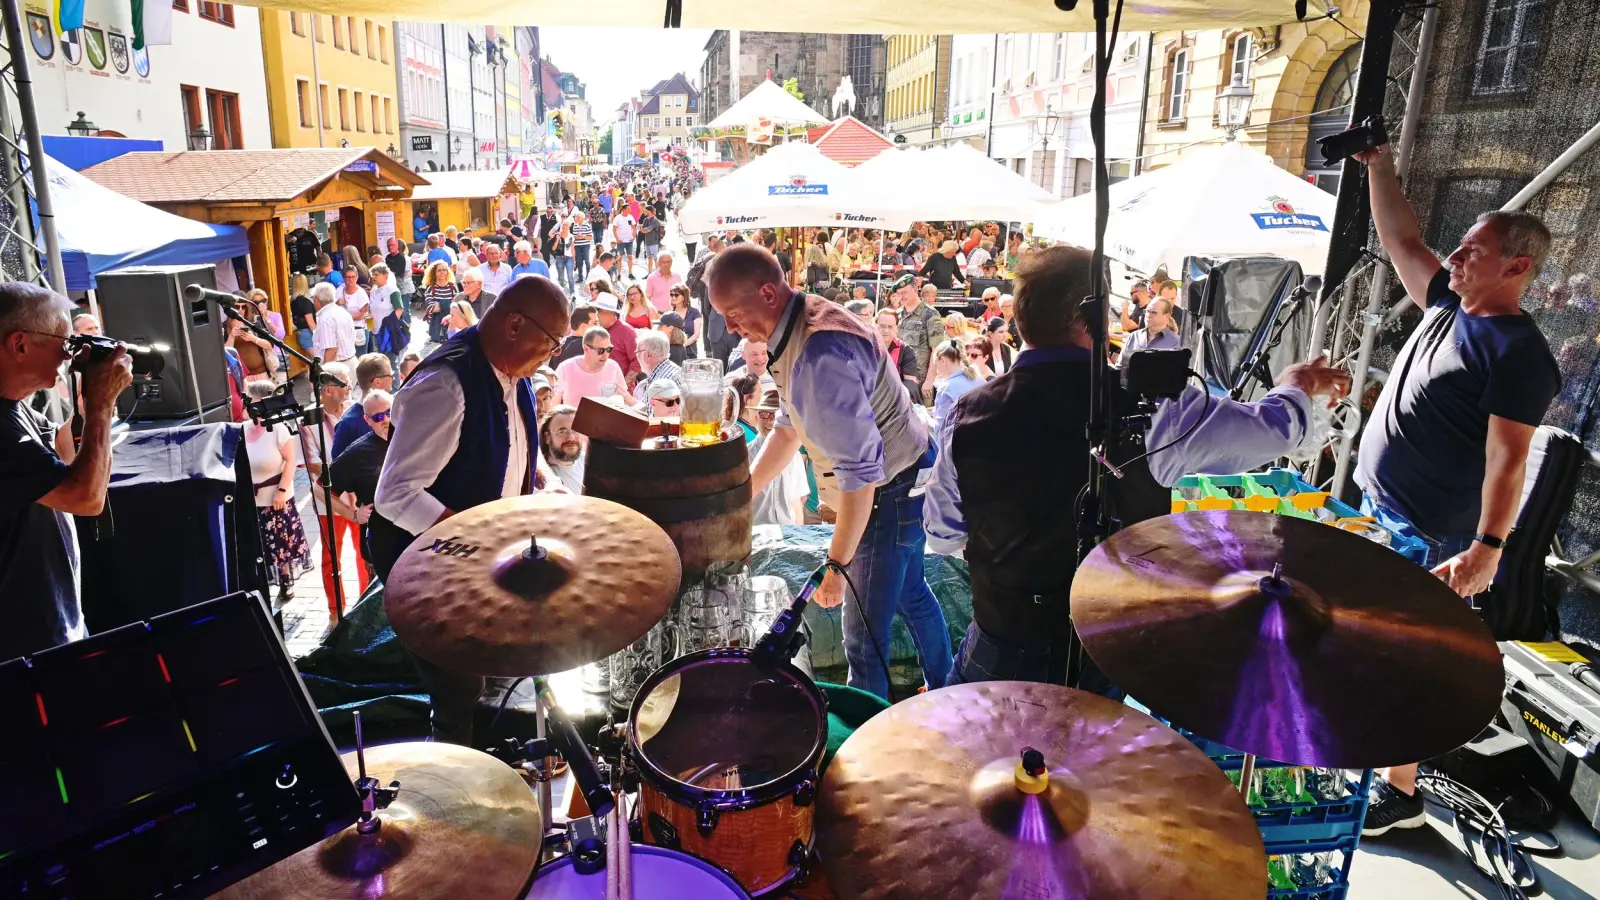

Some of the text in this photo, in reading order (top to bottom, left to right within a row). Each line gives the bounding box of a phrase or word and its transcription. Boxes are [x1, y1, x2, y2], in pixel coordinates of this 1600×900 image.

[774, 186, 824, 194] Tucher
[725, 215, 759, 224] Tucher
[843, 213, 877, 223] Tucher
[1260, 215, 1321, 227] Tucher
[417, 536, 480, 558] HHX
[1523, 711, 1566, 744] STANLEY
